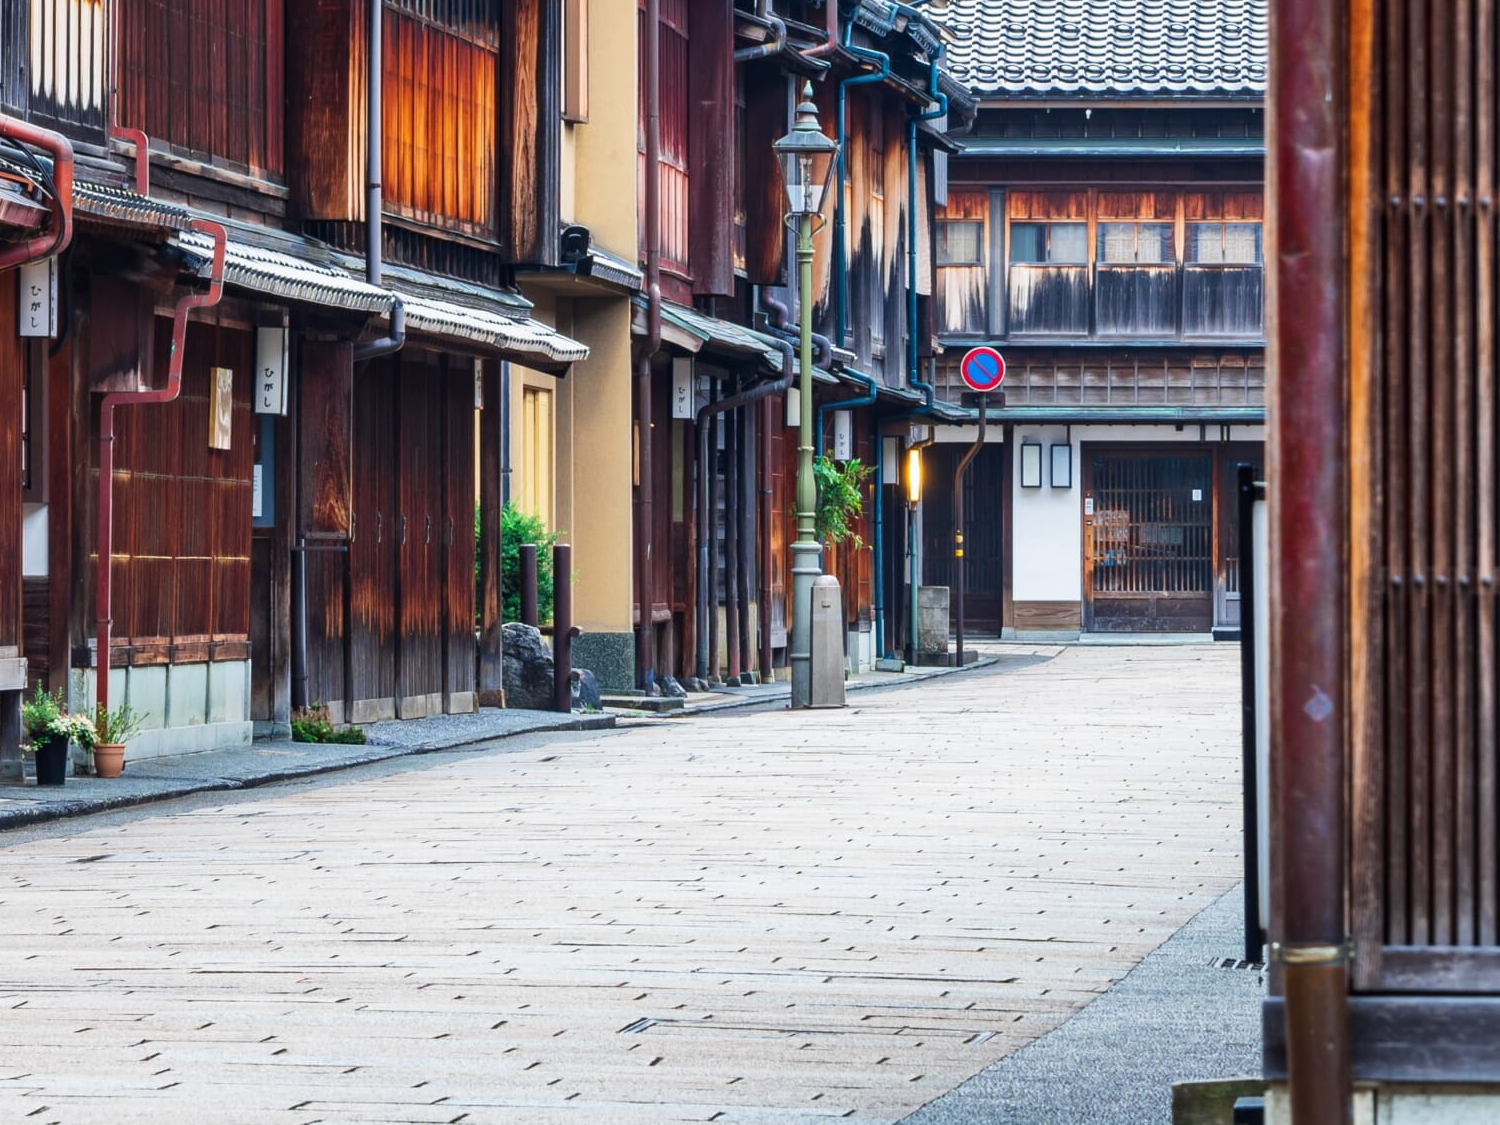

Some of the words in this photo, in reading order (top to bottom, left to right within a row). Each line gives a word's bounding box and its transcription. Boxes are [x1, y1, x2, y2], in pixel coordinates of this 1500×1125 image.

[30, 285, 42, 328] ひがし
[263, 368, 274, 408] ひがし
[678, 386, 686, 413] ひがし
